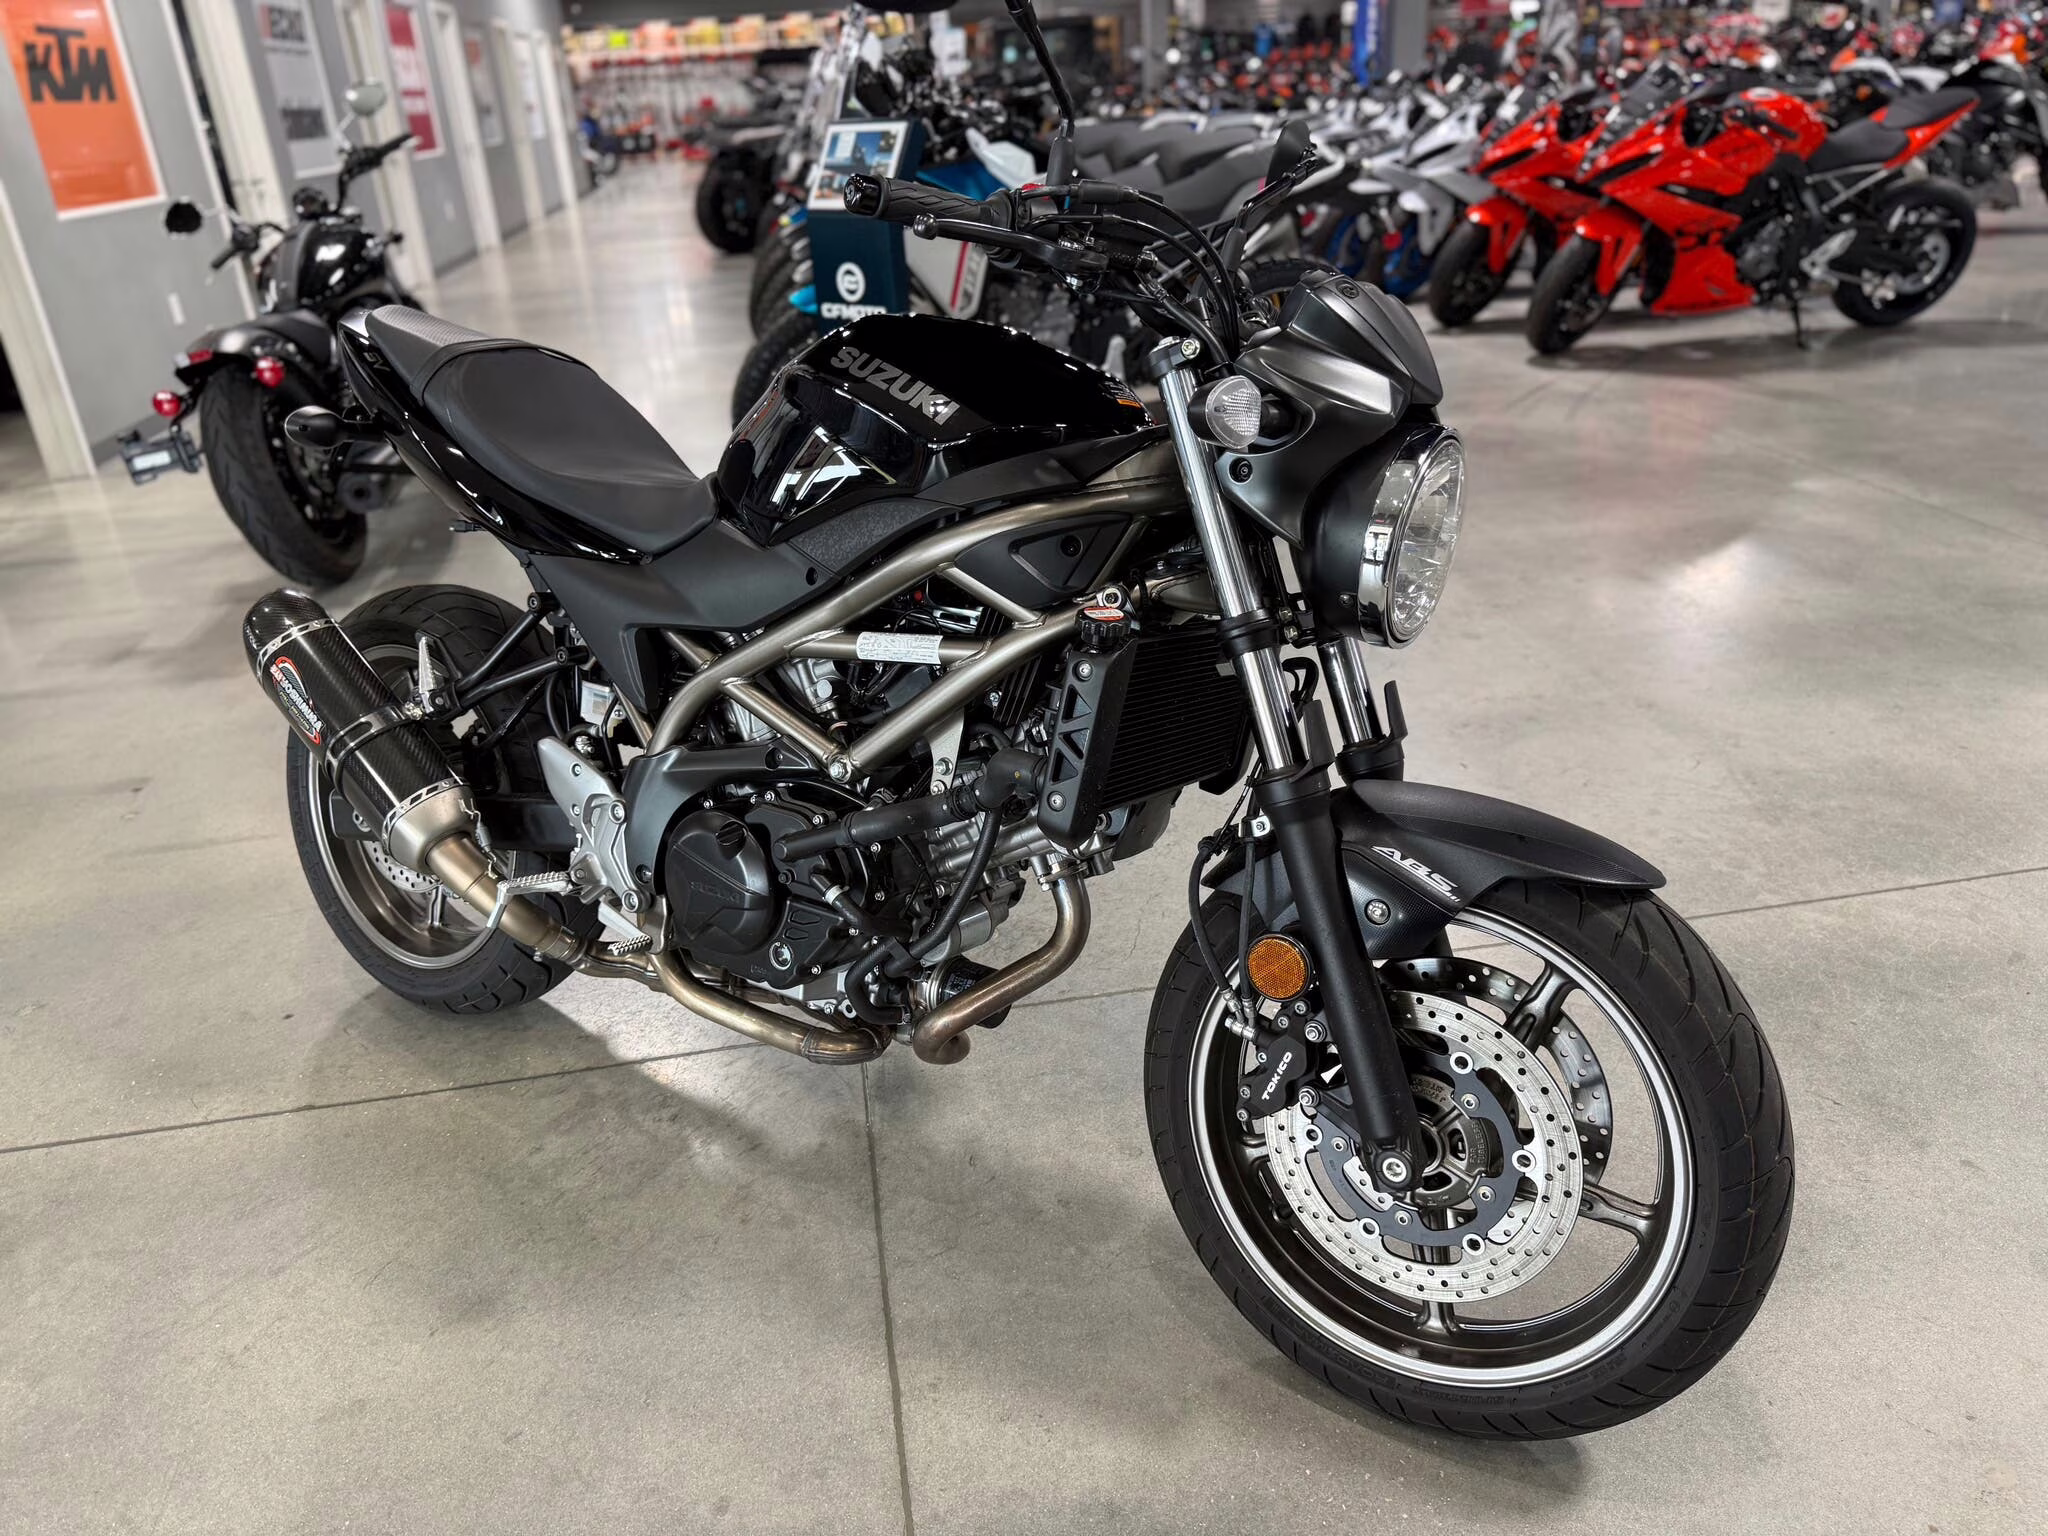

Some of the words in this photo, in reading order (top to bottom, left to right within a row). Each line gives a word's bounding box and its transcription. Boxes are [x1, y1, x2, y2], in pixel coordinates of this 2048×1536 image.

[24, 25, 117, 103] KTM
[830, 346, 961, 426] SUZUKI
[1371, 846, 1460, 894] ABS
[1261, 1051, 1293, 1100] TOKICO
